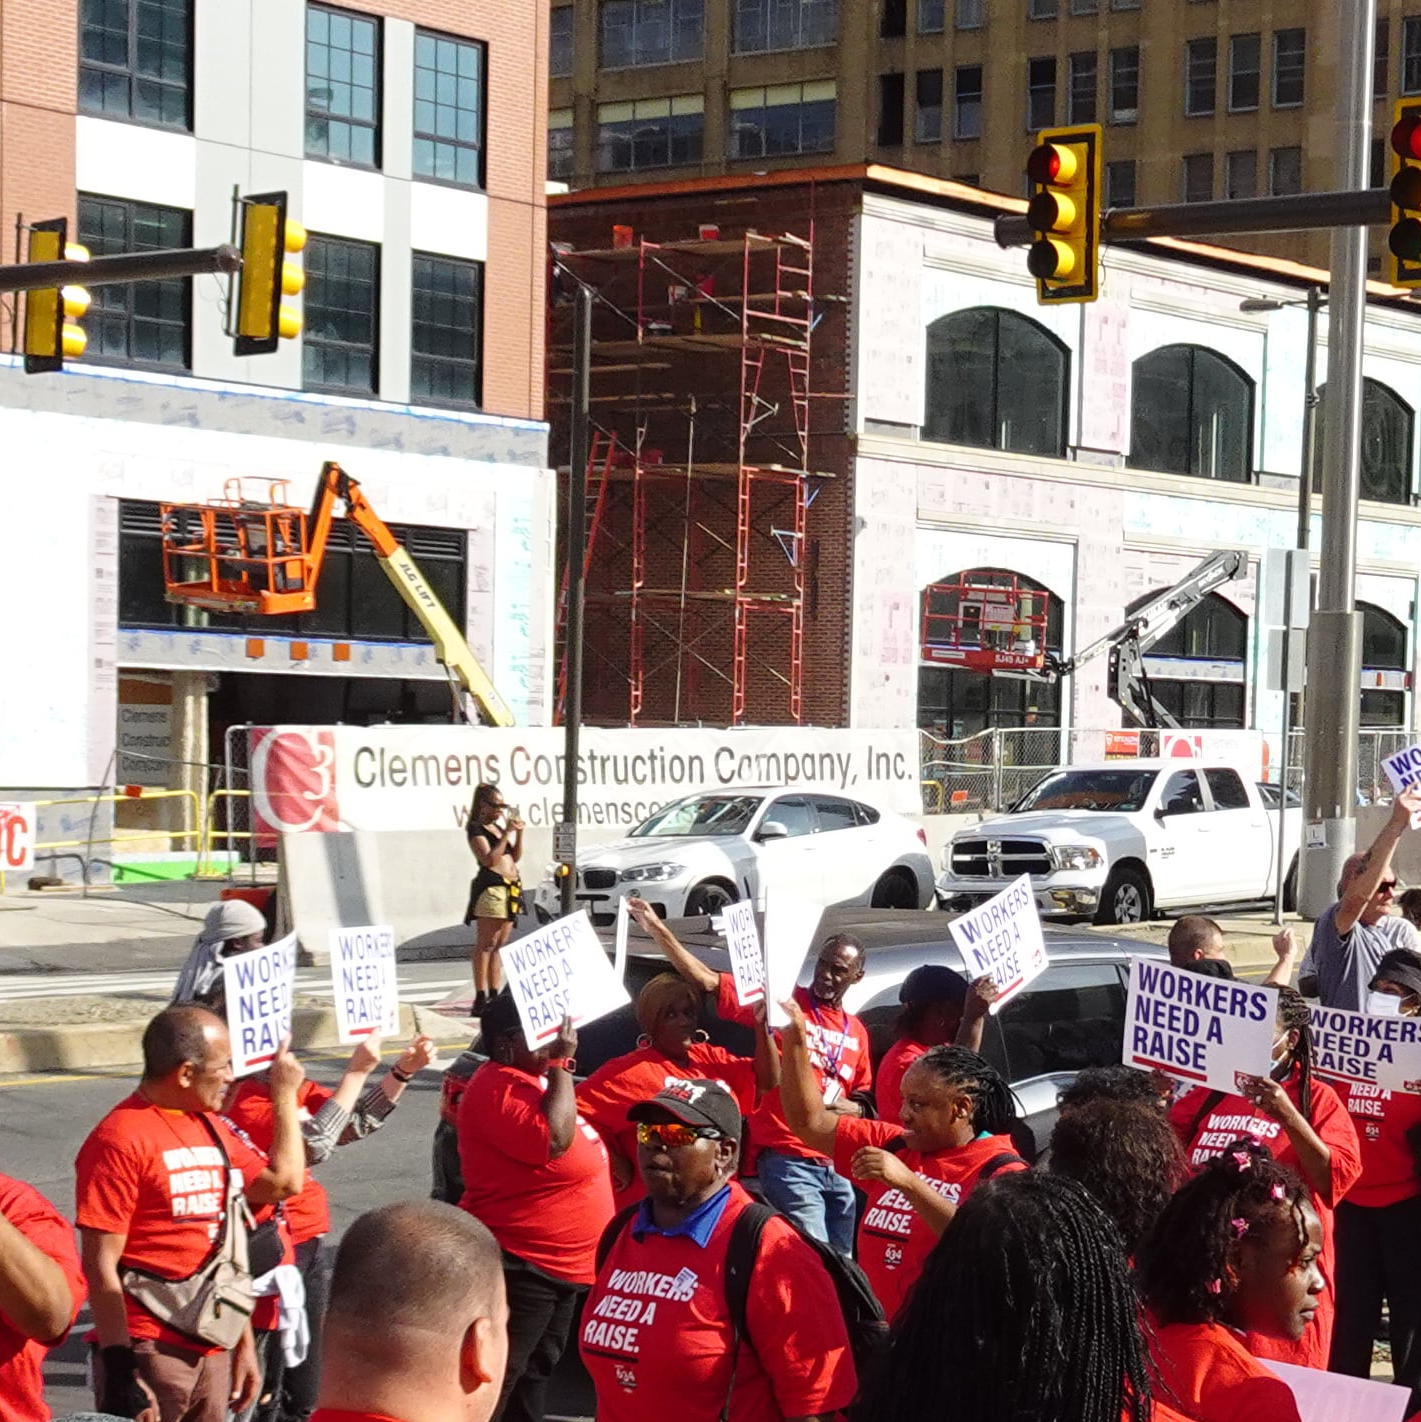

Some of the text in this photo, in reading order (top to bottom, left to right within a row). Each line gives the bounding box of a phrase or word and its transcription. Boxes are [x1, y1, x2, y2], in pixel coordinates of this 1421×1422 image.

[353, 746, 502, 788] Clemens
[868, 745, 913, 782] Inc.
[959, 883, 1029, 945] WORKERS
[972, 921, 1021, 971] NEED A
[519, 964, 560, 1003] NEED
[996, 951, 1022, 987] AISE
[1138, 962, 1267, 1022] WORKERS
[1135, 994, 1223, 1045] NEED A
[1132, 1024, 1207, 1070] RAISE
[1377, 1044, 1394, 1064] A
[1320, 1052, 1377, 1079] AISE
[1350, 1083, 1381, 1097] NEED
[1347, 1098, 1386, 1117] RAISE.
[1208, 1114, 1281, 1138] WORKERS
[864, 1207, 912, 1235] RAISE.
[884, 1248, 903, 1261] 634
[593, 1294, 657, 1326] NEED A
[582, 1320, 640, 1354] RAISE.
